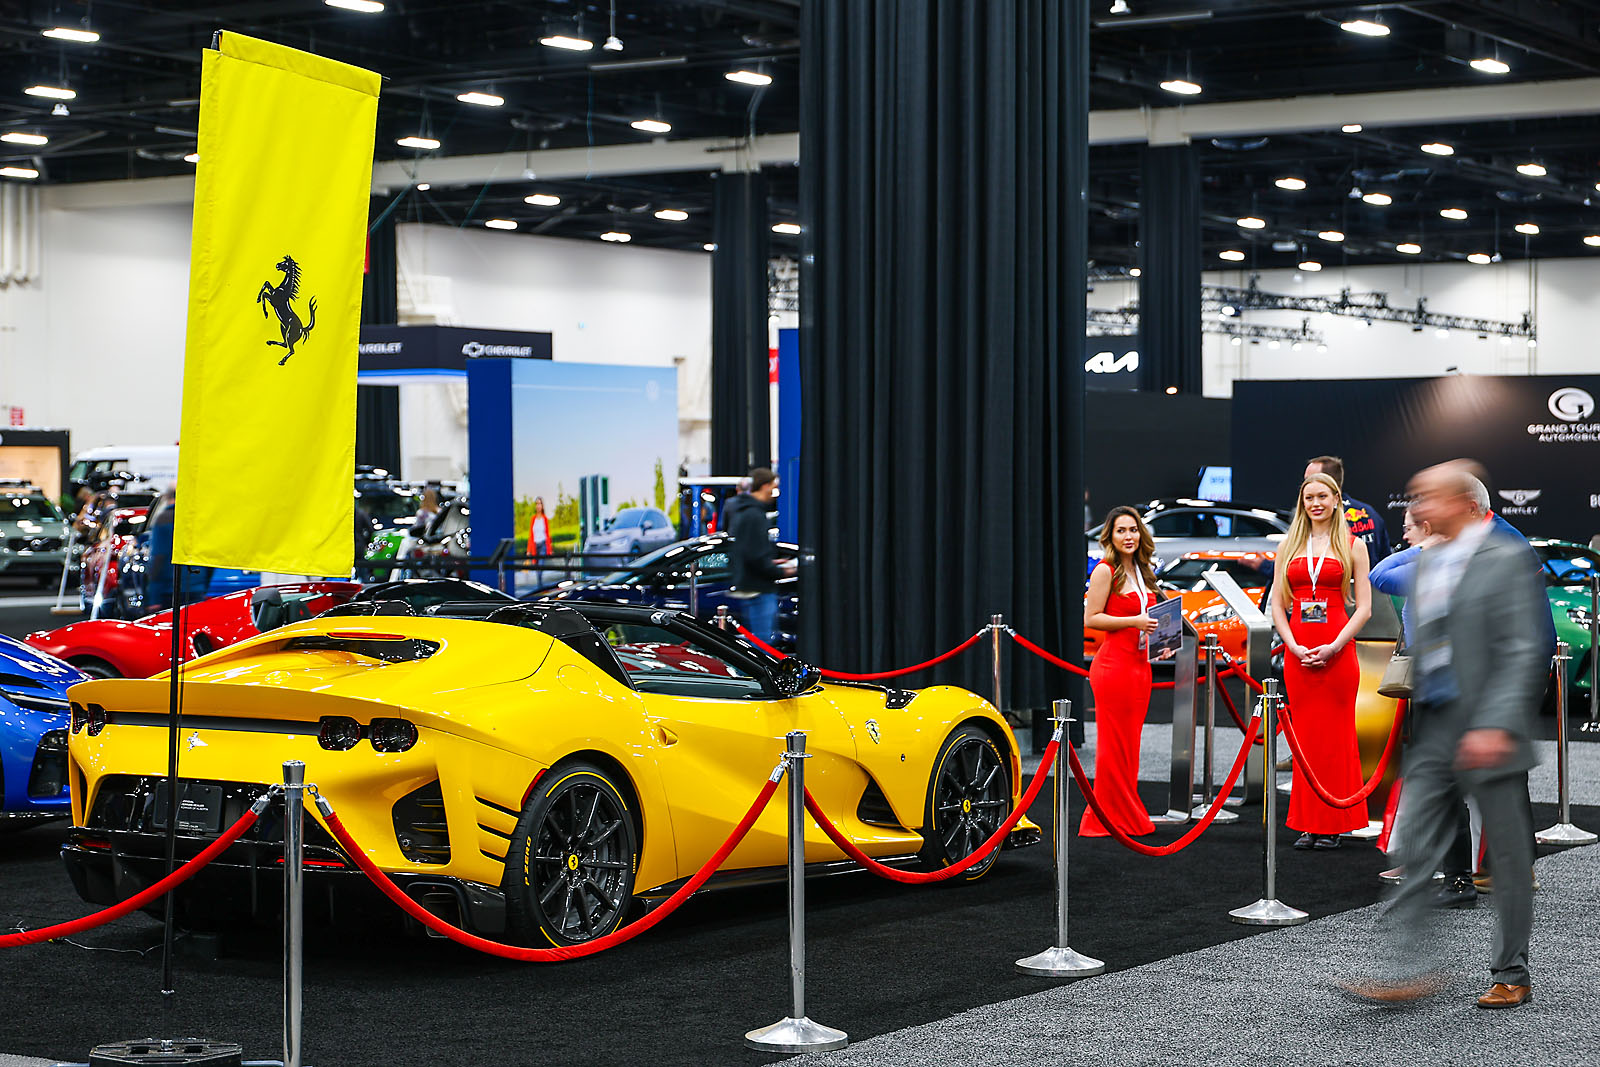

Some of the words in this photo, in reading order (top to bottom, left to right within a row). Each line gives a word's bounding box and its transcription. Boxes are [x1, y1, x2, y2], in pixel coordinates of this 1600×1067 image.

[358, 342, 402, 355] VROLET
[485, 345, 532, 357] CHEVROLET
[1527, 424, 1568, 435] GRAND
[1569, 423, 1600, 433] TOUR
[1539, 433, 1600, 442] AUTOMOBIL
[1501, 506, 1538, 516] BENTLEY
